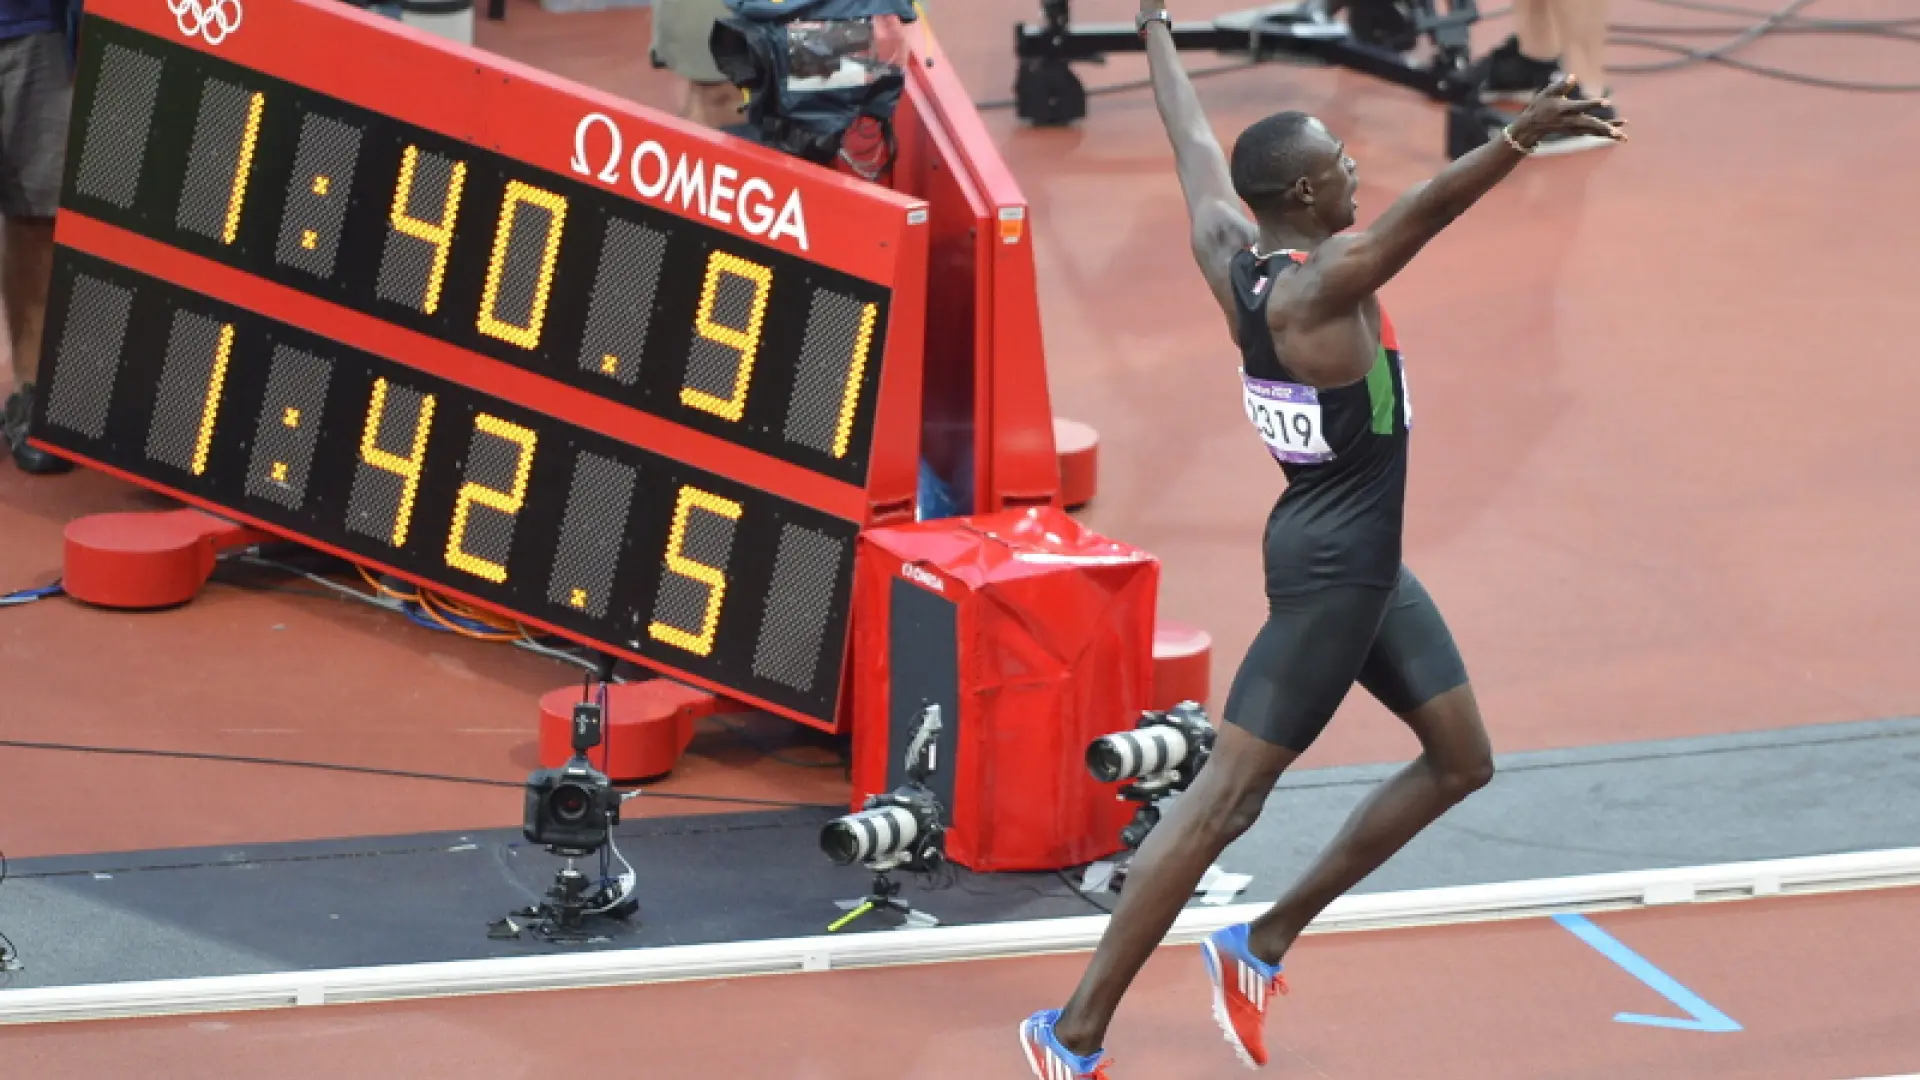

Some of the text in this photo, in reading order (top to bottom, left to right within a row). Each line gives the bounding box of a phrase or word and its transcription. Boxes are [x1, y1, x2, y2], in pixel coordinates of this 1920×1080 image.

[224, 92, 877, 458] 1:40.91
[630, 140, 809, 251] OMEGA
[192, 324, 742, 656] 1:42.5
